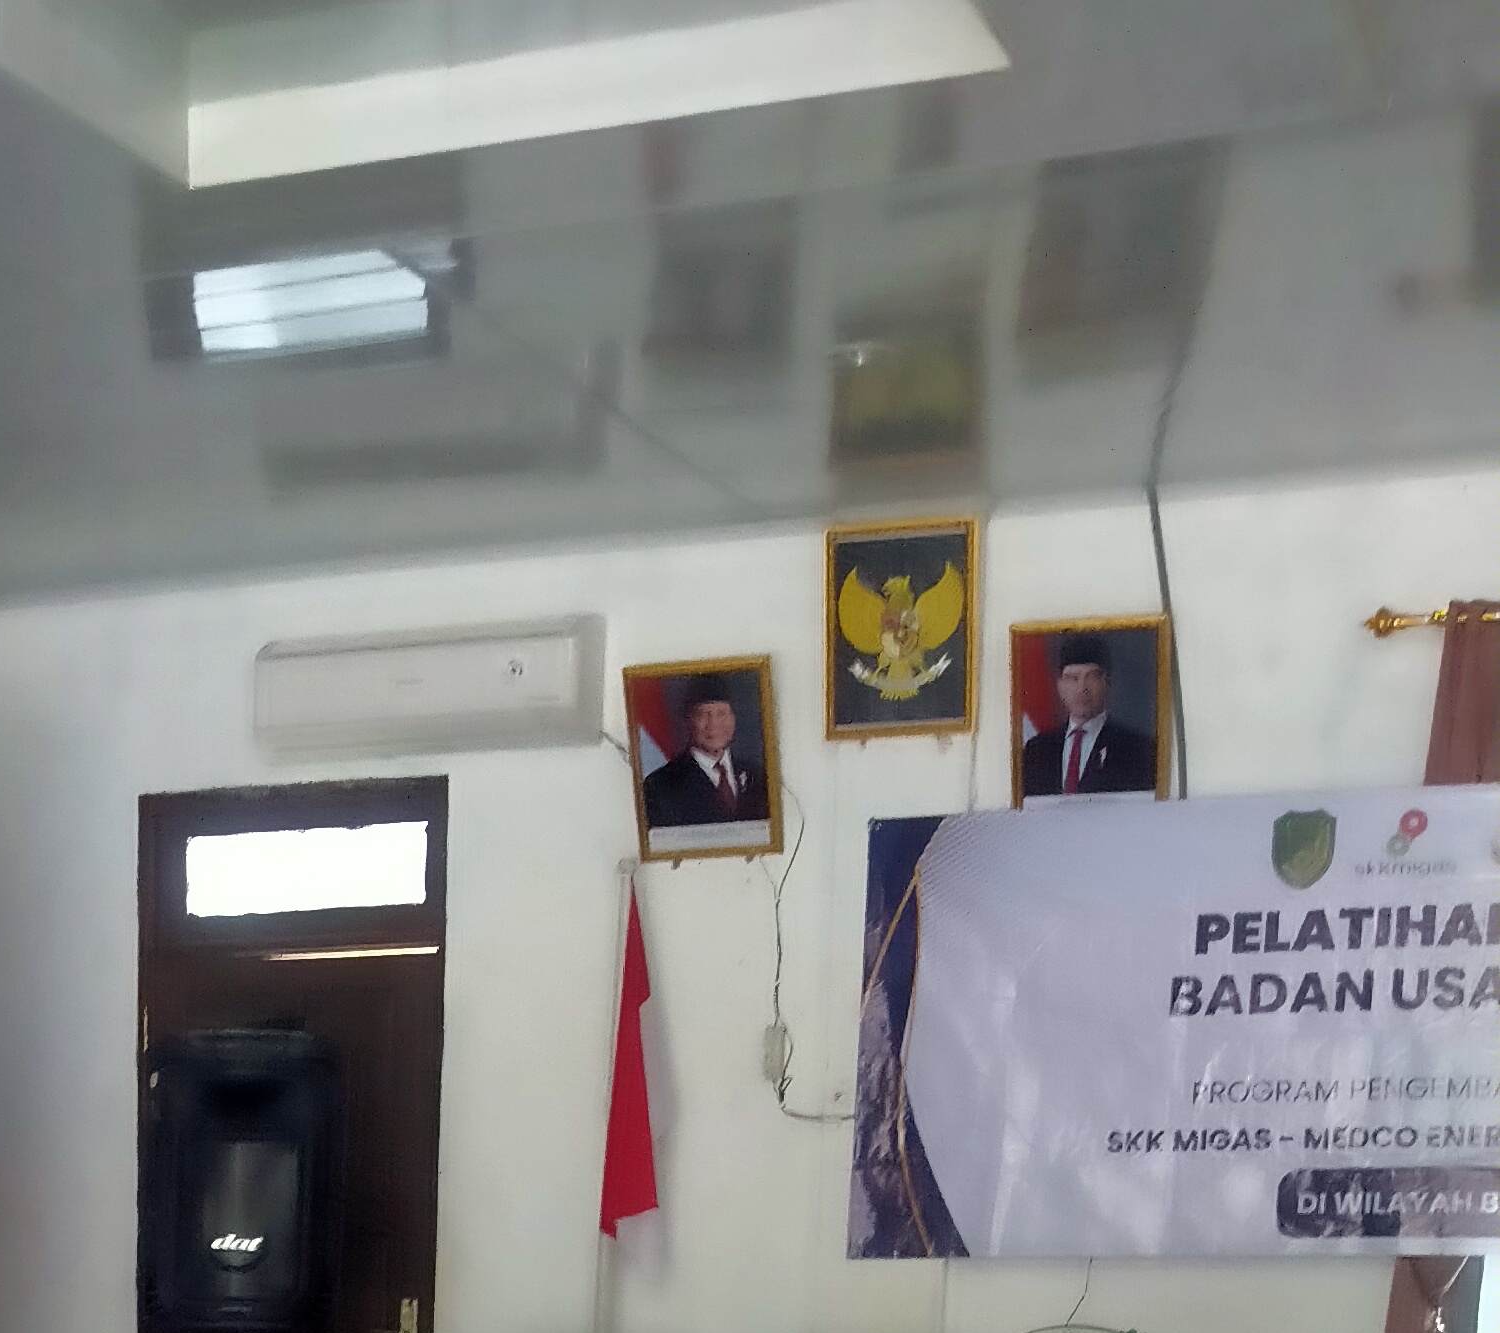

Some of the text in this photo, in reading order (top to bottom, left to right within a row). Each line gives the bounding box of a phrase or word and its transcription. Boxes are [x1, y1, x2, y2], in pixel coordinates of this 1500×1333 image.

[1169, 967, 1375, 1016] BADAN
[1193, 1078, 1339, 1104] PROGRAM
[1107, 1130, 1165, 1152] SKK
[1173, 1128, 1272, 1152] MIGAS
[1303, 1125, 1419, 1150] MEDCO
[1296, 1191, 1328, 1215] DI
[1334, 1190, 1472, 1215] WILAYAH
